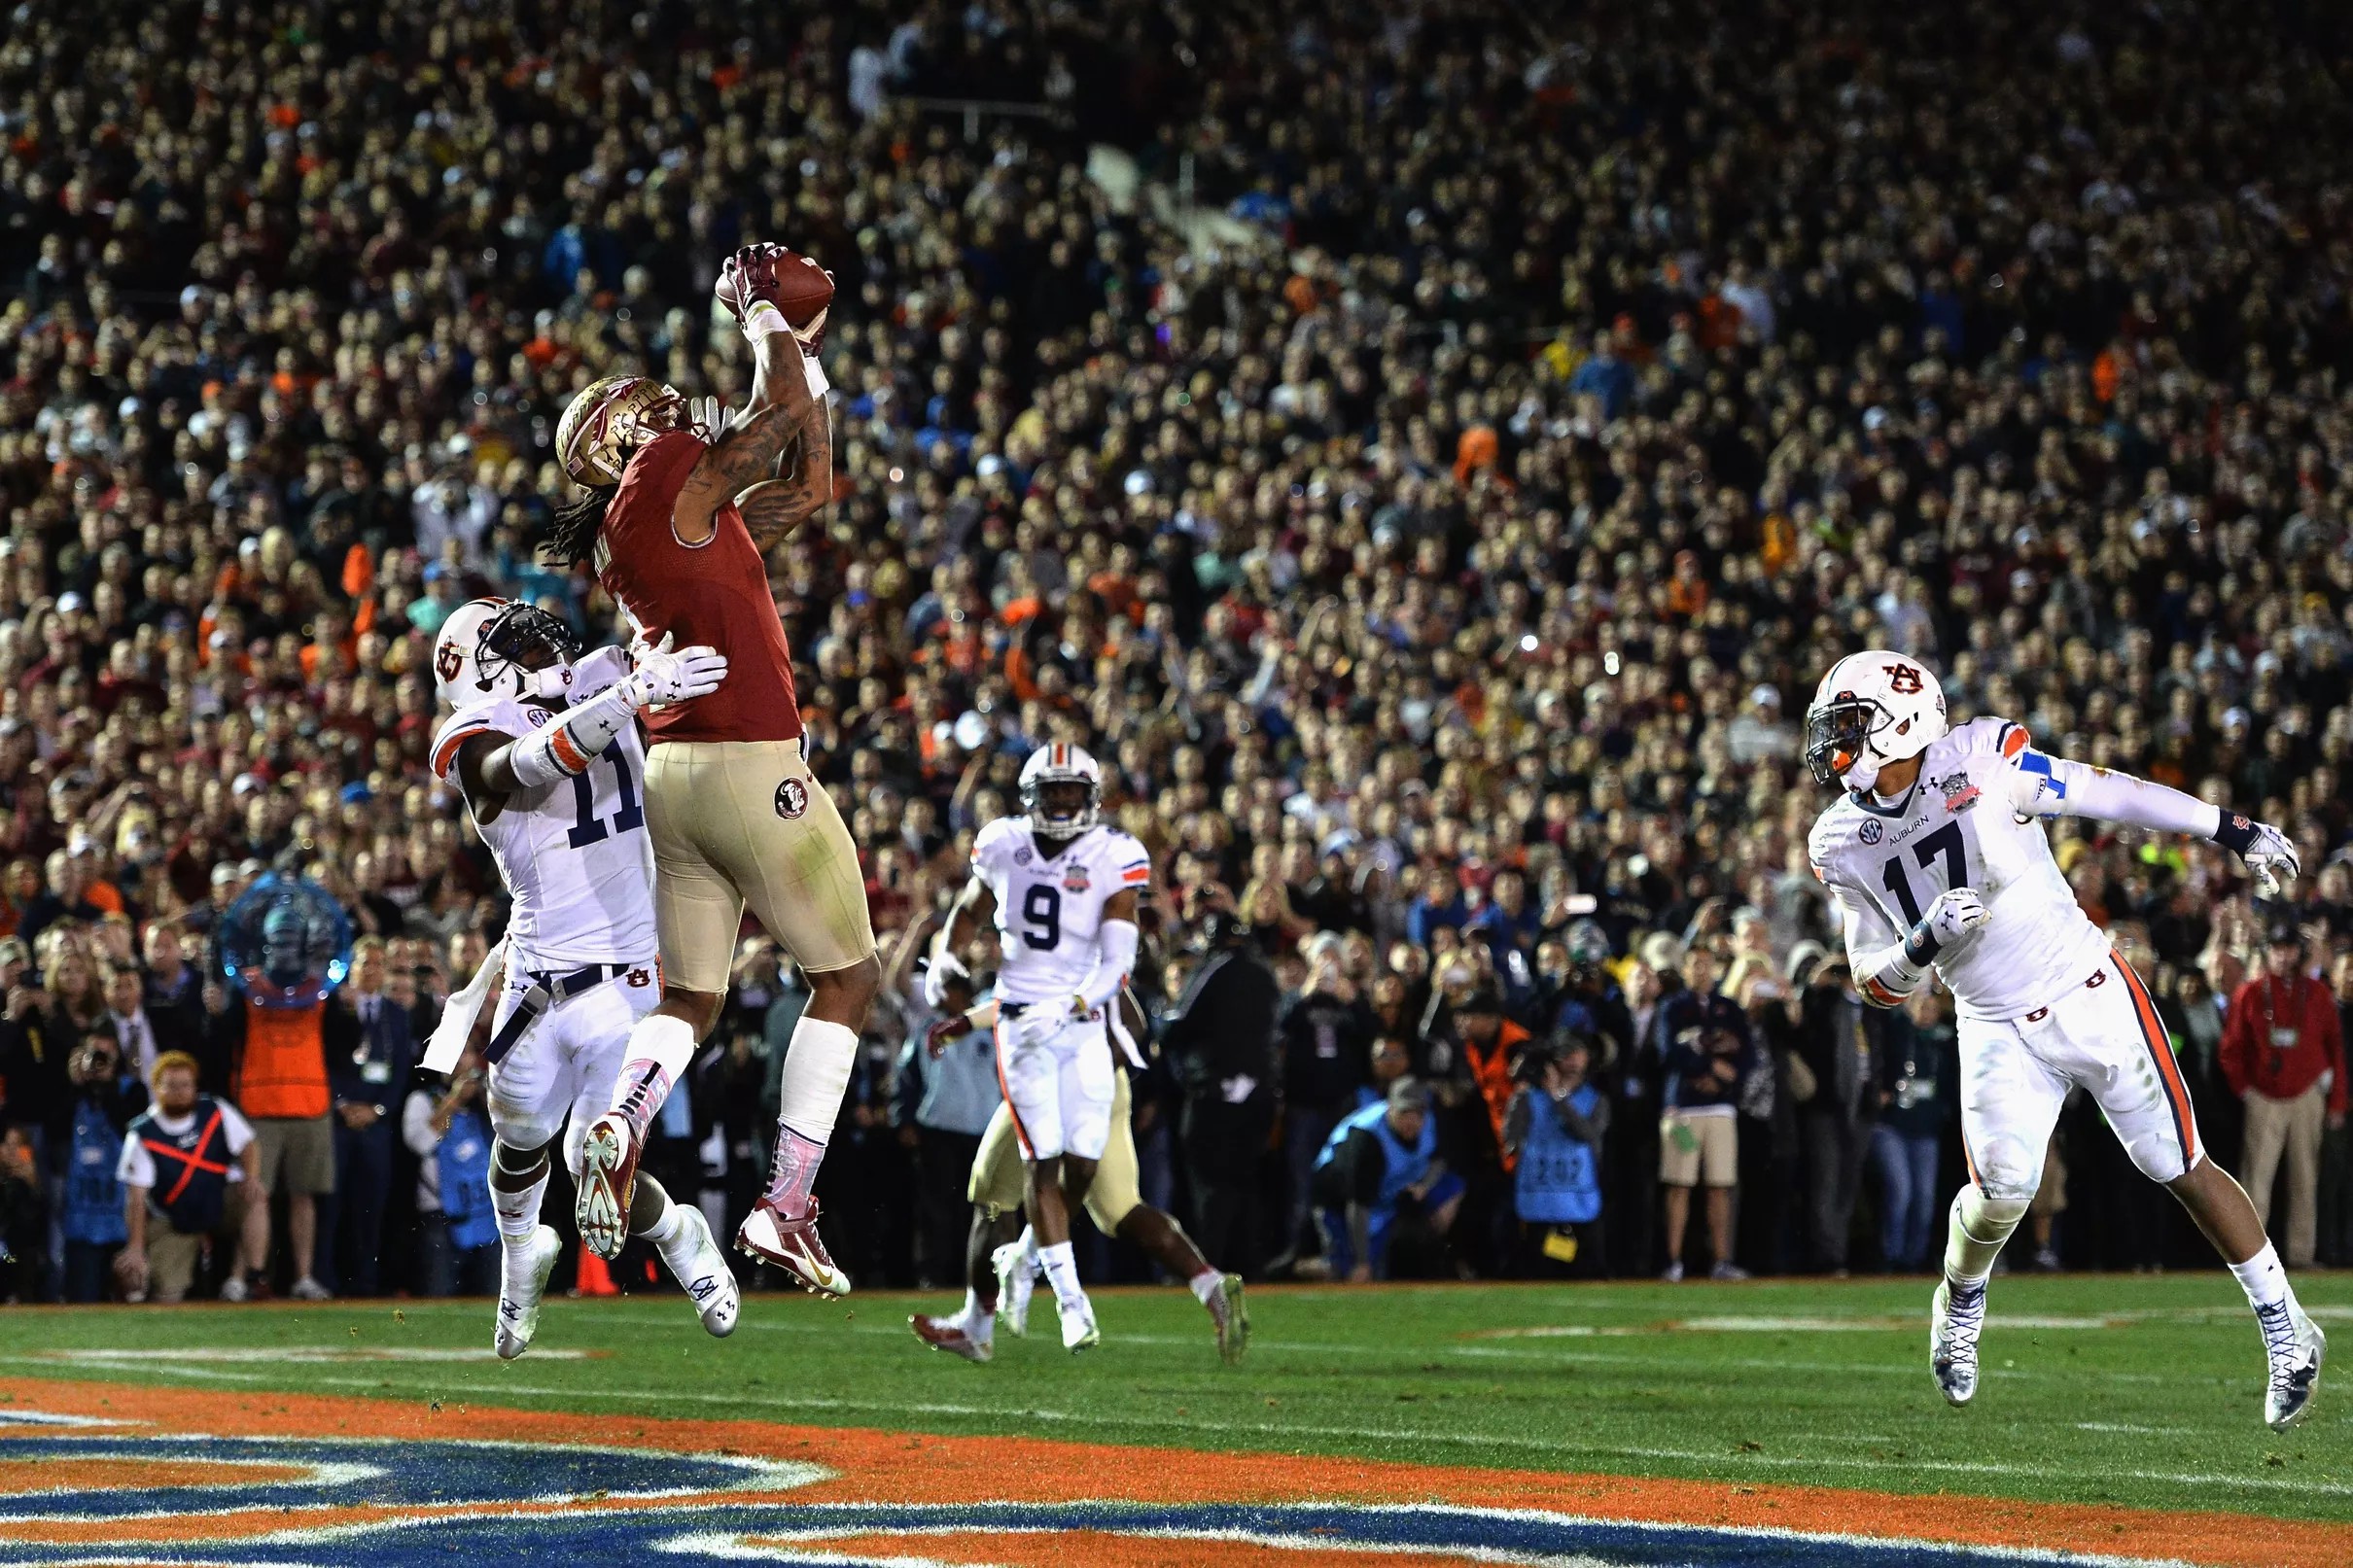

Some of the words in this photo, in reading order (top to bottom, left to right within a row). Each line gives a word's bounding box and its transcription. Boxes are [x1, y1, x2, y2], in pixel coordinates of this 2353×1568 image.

[1881, 663, 1923, 694] AU
[567, 737, 644, 849] 11
[1860, 819, 1882, 845] SEC
[1889, 816, 1929, 847] AUBURN
[1882, 819, 1968, 930] 17
[1023, 884, 1060, 952] 9
[625, 968, 650, 988] AU
